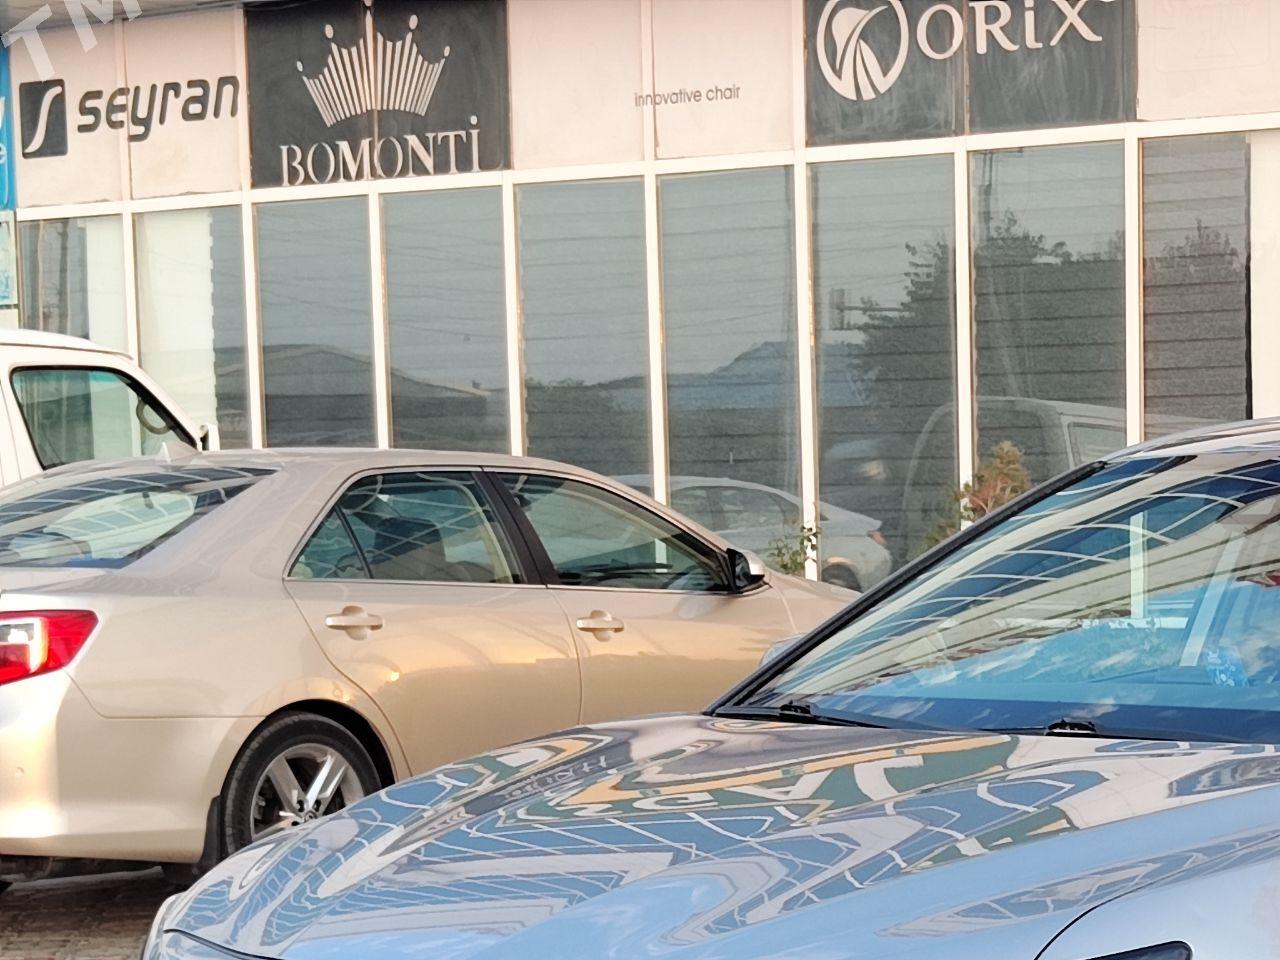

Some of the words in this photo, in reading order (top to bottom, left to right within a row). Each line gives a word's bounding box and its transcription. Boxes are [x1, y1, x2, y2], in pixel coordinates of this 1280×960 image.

[77, 75, 240, 142] seyran
[634, 88, 703, 107] innovative
[705, 83, 741, 102] chair
